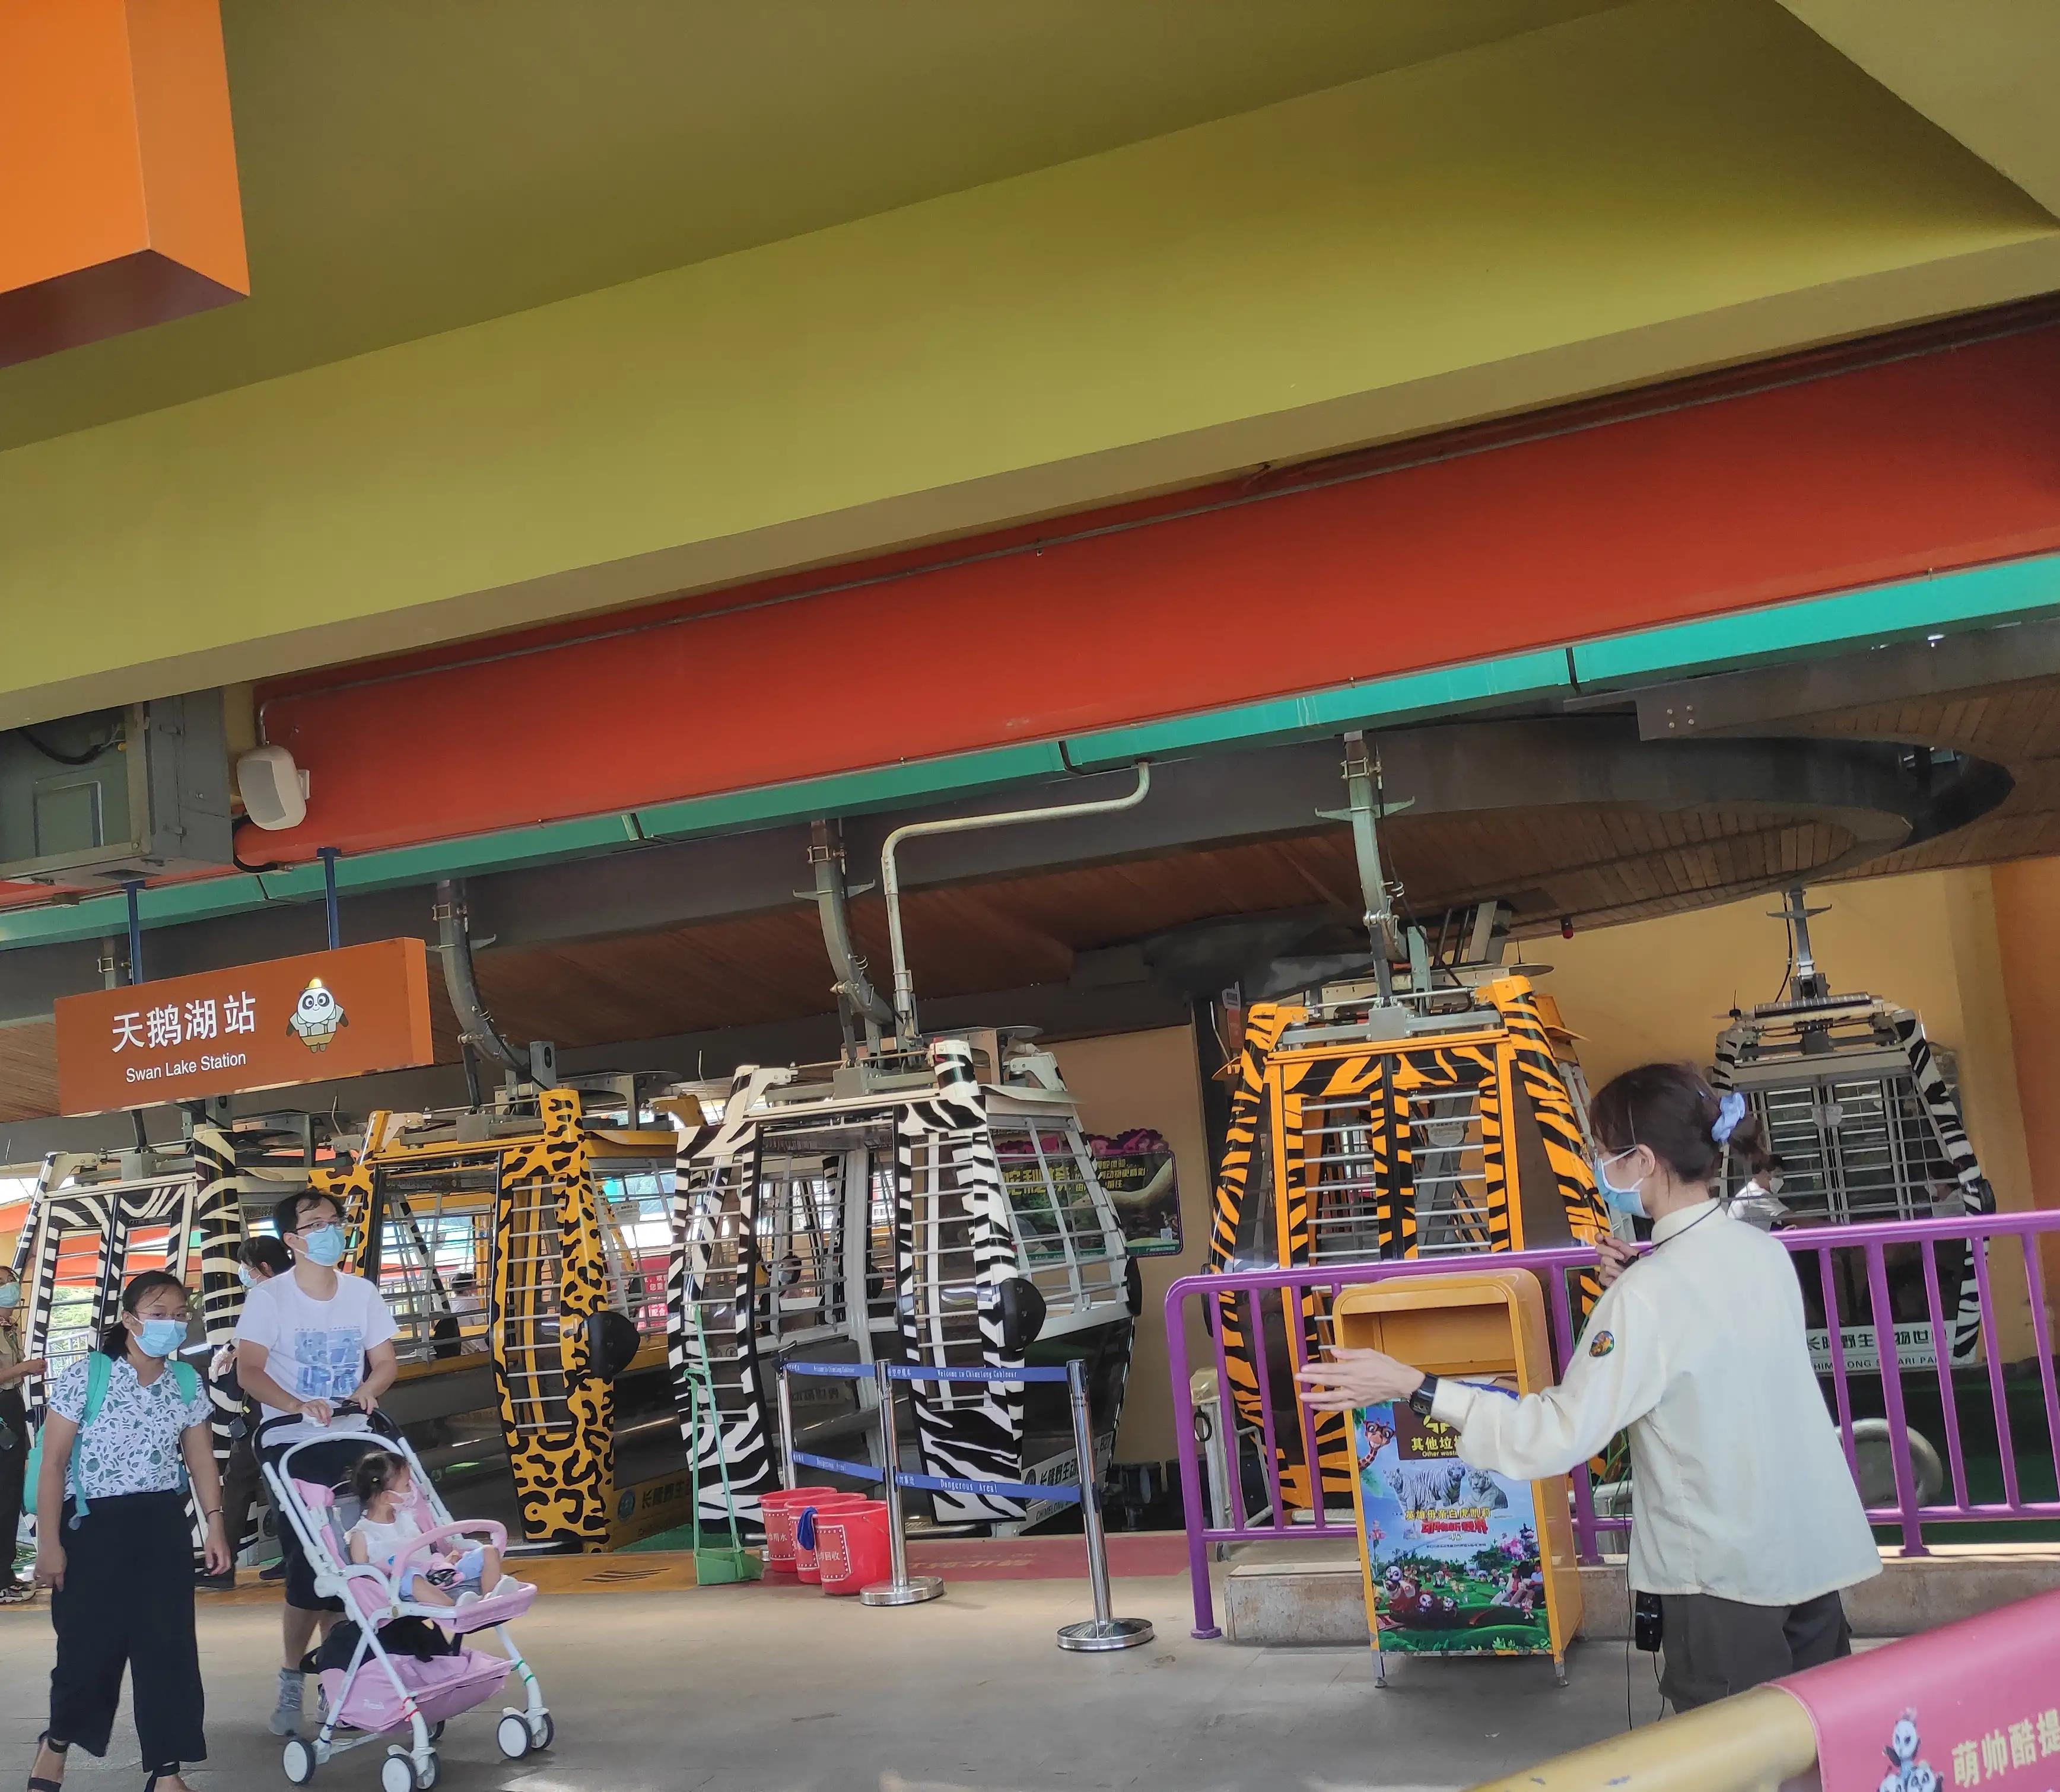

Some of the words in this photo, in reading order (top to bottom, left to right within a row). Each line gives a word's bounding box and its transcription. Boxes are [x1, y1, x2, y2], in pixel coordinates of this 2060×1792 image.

[112, 991, 256, 1053] 天鹅湖站
[126, 1067, 161, 1083] Swan
[166, 1059, 197, 1077] Lake
[201, 1052, 246, 1071] Station
[965, 1370, 991, 1379] Chimelong
[993, 1370, 1017, 1378] Cablecar
[940, 1479, 973, 1491] Dangerous
[1951, 1708, 2060, 1788] 萌帅酷提
